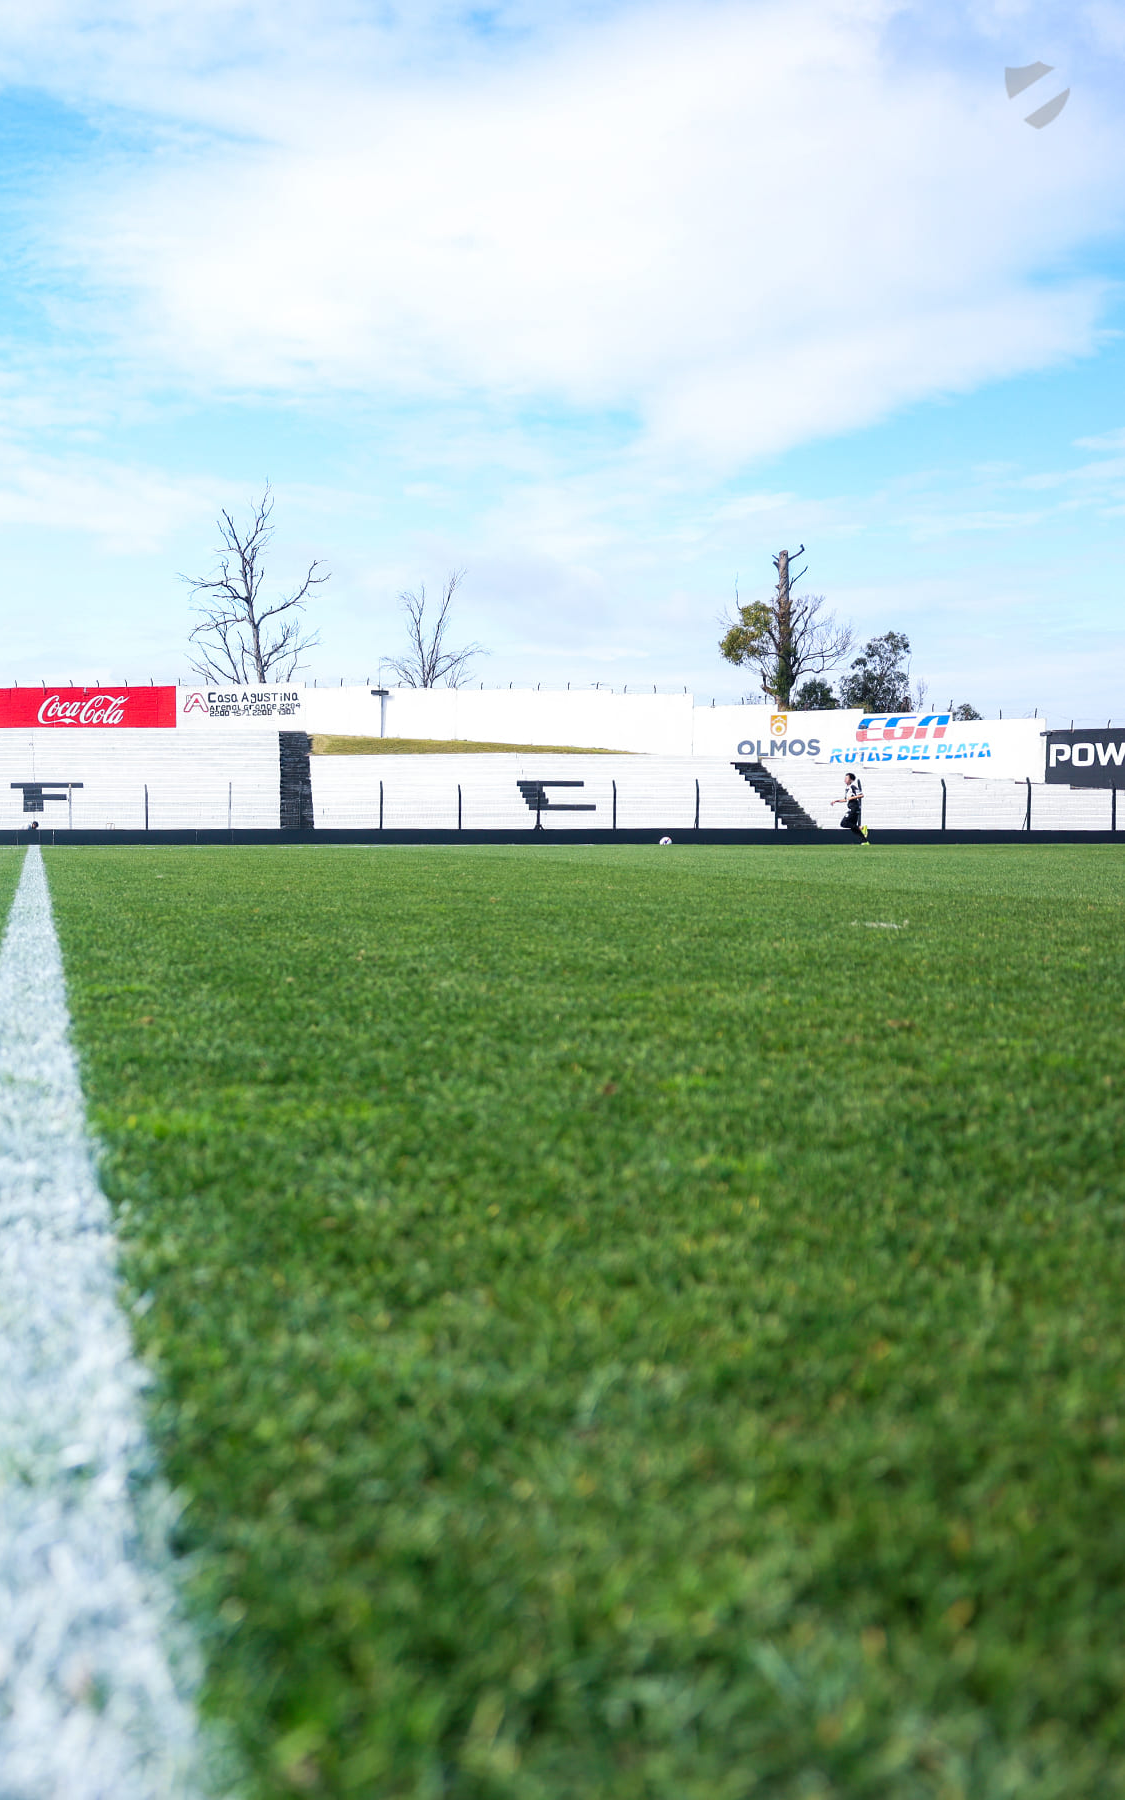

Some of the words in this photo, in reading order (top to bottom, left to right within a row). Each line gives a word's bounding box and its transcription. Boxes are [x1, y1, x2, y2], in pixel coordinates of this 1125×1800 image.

[37, 695, 129, 724] Coca-Cola
[737, 739, 821, 756] OLMOS
[830, 746, 893, 764] RUTAS
[897, 744, 931, 761] DEL
[935, 742, 992, 760] PLATA
[10, 782, 84, 812] F
